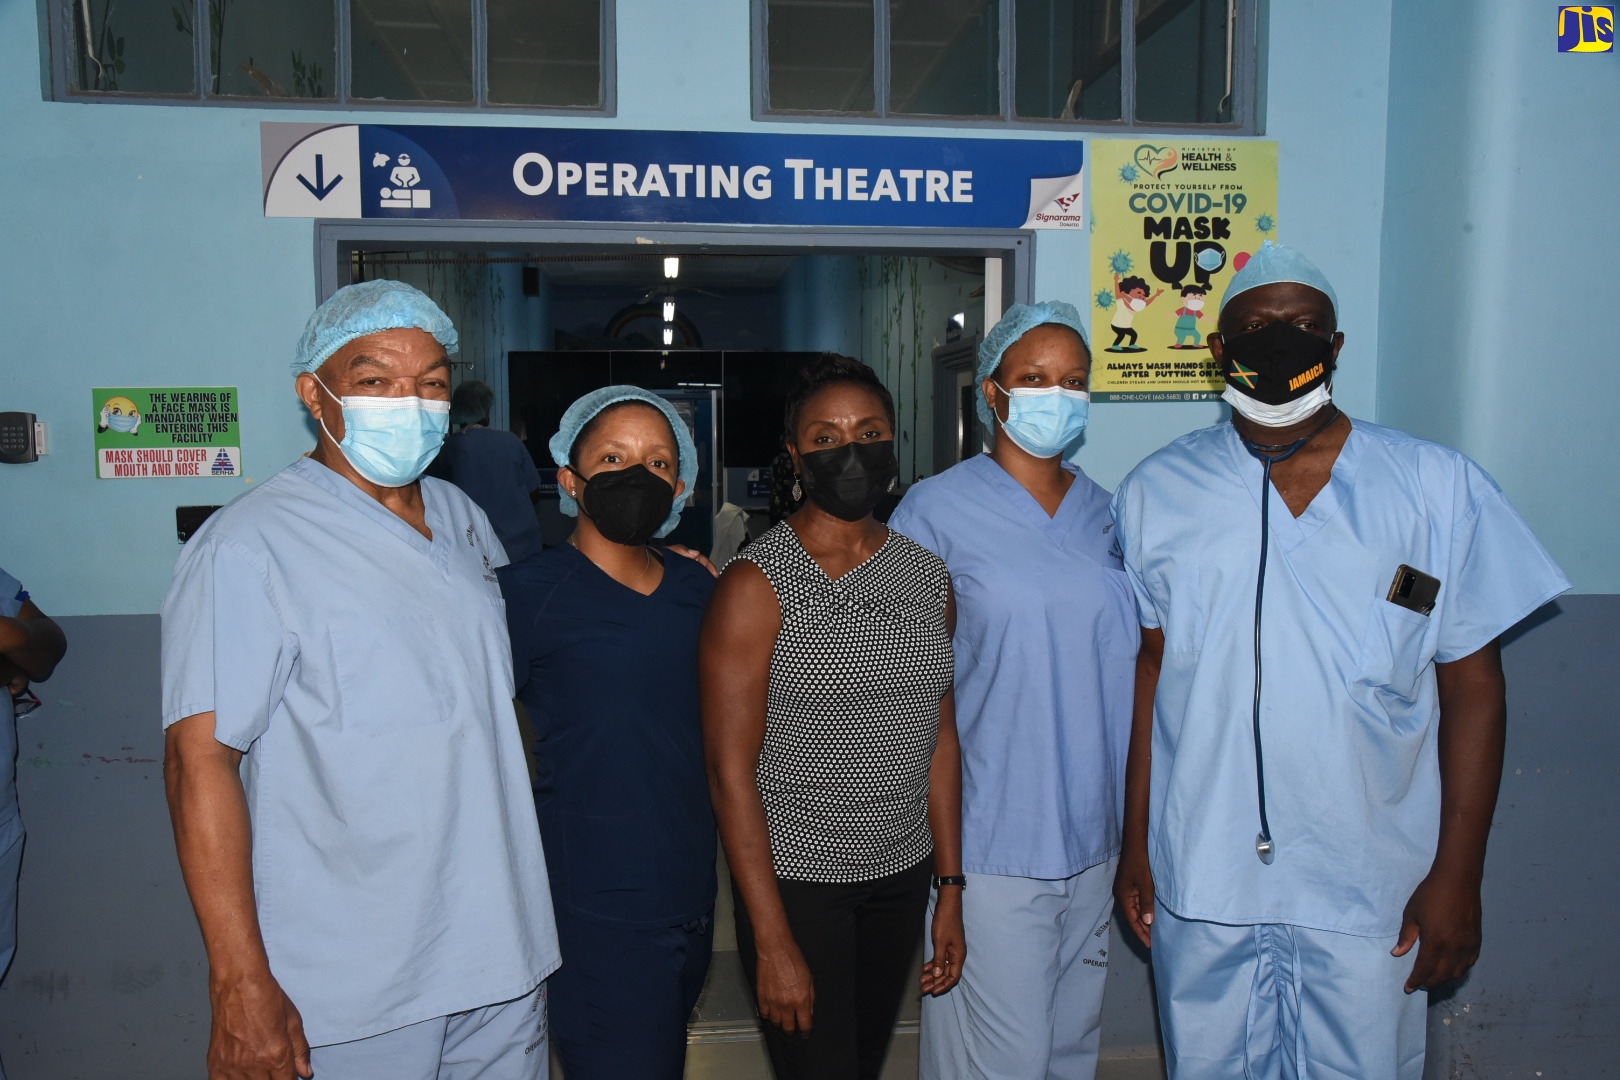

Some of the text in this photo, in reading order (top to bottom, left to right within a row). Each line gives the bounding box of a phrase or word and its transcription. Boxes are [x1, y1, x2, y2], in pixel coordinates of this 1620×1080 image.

[1181, 152, 1233, 162] HEALTH &
[1181, 162, 1237, 171] WELLNESS
[512, 152, 974, 203] OPERATING THEATRE
[1128, 192, 1248, 214] COVID-19
[1035, 213, 1081, 222] Signarama
[1143, 216, 1231, 240] MASK
[1149, 241, 1227, 283] UP
[1146, 362, 1172, 370] WASH
[1173, 362, 1204, 370] HANDS
[1121, 370, 1150, 378] AFTER
[1154, 370, 1197, 378] PUTTING
[1198, 370, 1215, 378] ON
[1288, 362, 1325, 392] JAMAICA
[149, 392, 232, 403] THE WEARING OF
[151, 402, 230, 413] A FACE MASK IS
[145, 412, 238, 423] MANDATORY WHEN
[155, 423, 228, 433] ENTERING THIS
[171, 433, 213, 443] FACILITY
[105, 449, 207, 463] MASK SHOULD COVER
[114, 462, 200, 477] MOUTH AND NOSE
